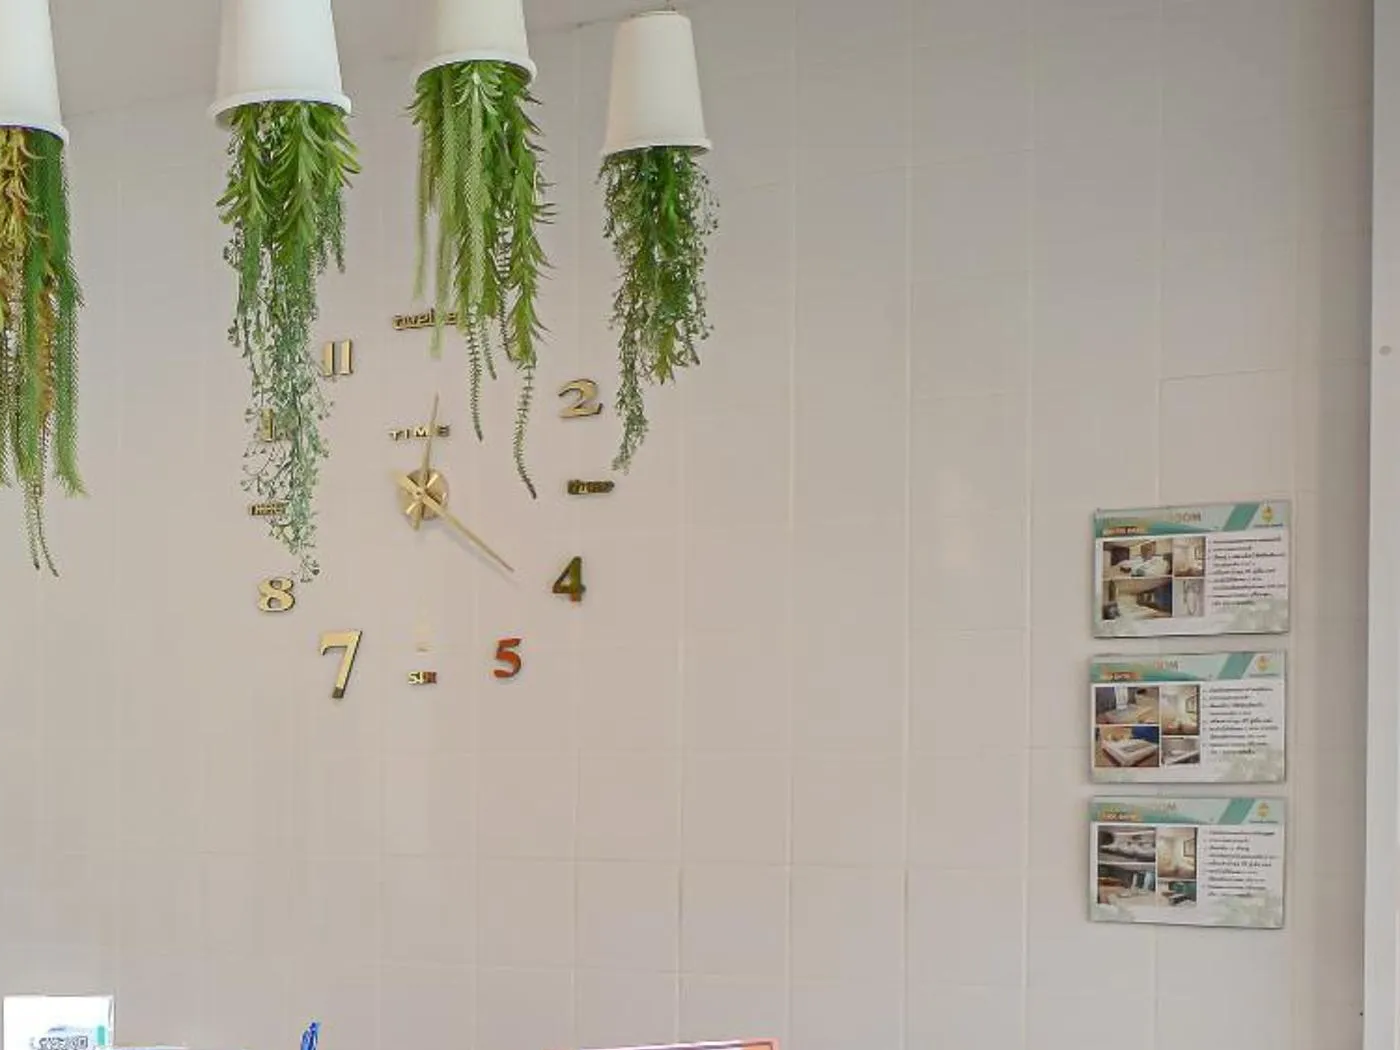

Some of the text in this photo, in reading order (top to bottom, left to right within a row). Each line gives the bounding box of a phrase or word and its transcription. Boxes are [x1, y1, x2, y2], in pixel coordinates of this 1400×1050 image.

[557, 378, 603, 419] 2
[388, 423, 451, 441] TIME
[256, 576, 296, 613] 8
[551, 555, 586, 602] 4
[319, 630, 363, 699] 7
[493, 638, 523, 679] 5
